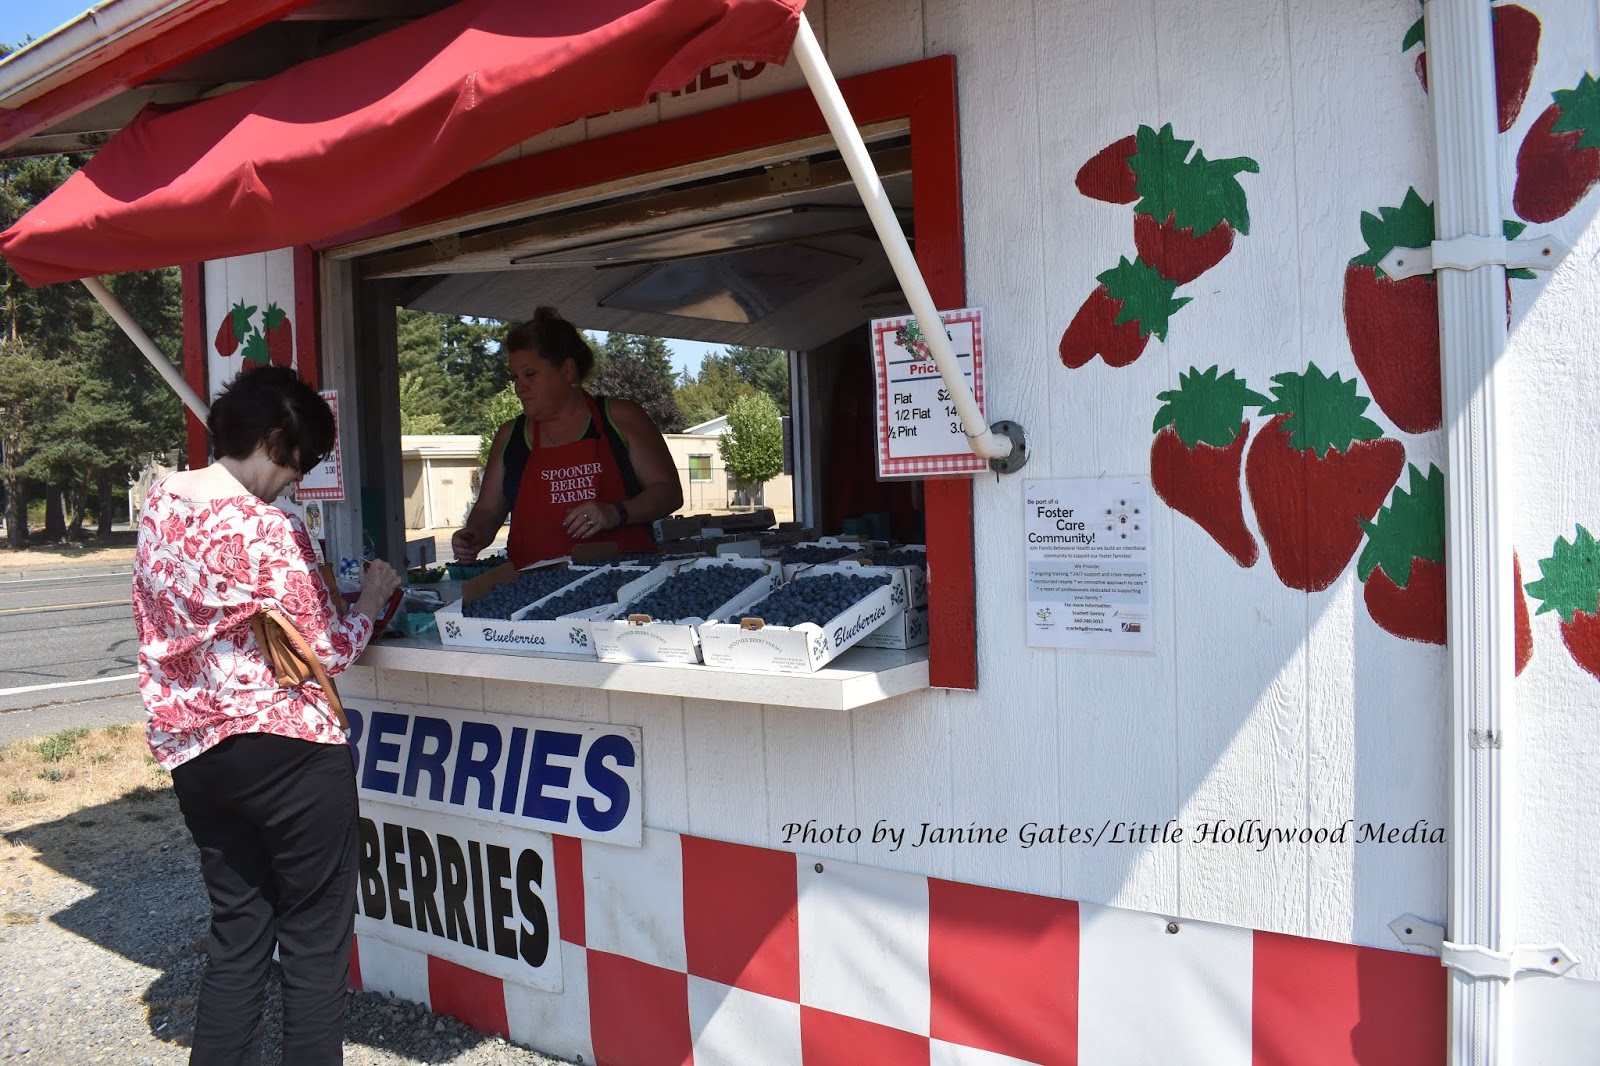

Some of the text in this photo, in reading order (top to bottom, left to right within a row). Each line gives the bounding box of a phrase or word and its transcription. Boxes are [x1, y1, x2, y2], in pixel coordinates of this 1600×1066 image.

[894, 393, 912, 405] Flat
[895, 405, 960, 421] 1/2 Flat 14.
[898, 425, 917, 437] Pint
[950, 422, 965, 433] 3.0
[325, 466, 336, 475] 3.00
[541, 462, 603, 481] SPOONER
[550, 476, 594, 492] BERRY
[550, 488, 597, 504] FARMS
[1037, 506, 1074, 518] Foster
[1056, 519, 1085, 531] Care
[1028, 532, 1095, 545] Community!
[833, 605, 886, 648] Blueberries
[483, 628, 546, 646] Blueberries
